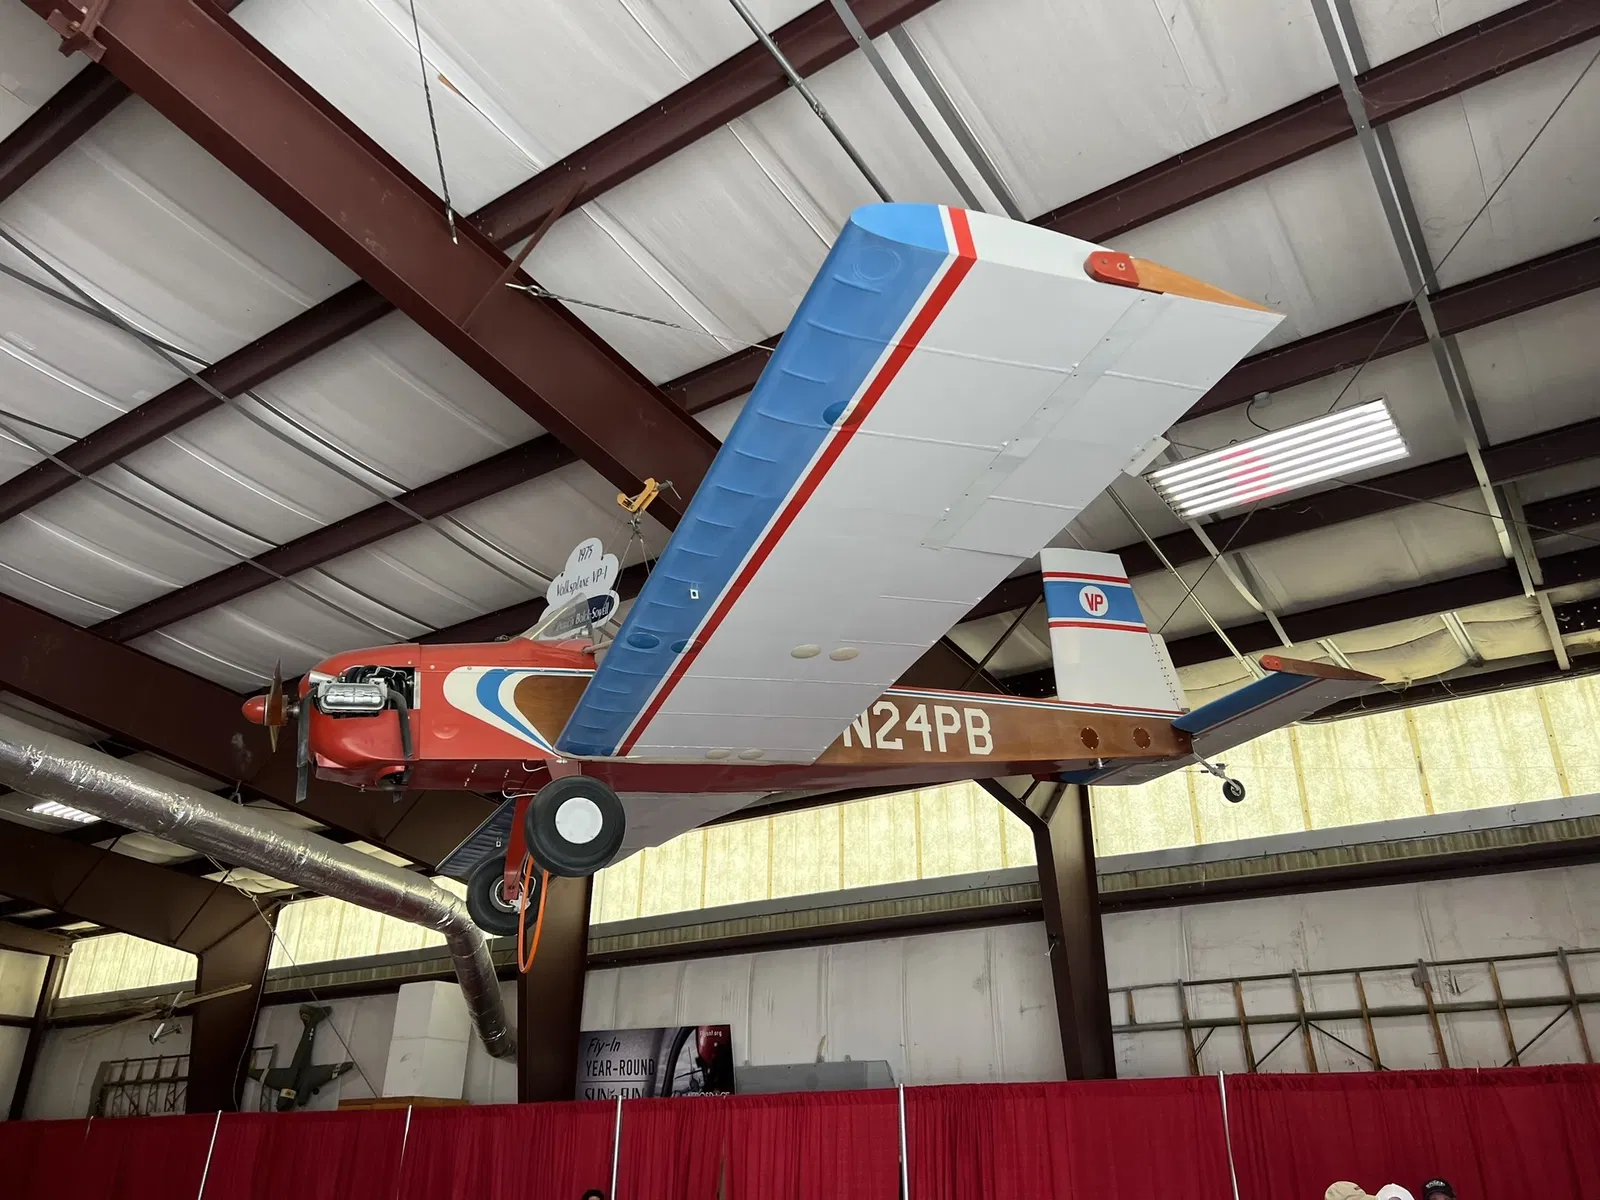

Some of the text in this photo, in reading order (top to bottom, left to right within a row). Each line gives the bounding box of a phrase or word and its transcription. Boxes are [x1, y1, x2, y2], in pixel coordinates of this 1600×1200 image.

[577, 544, 594, 562] 1975
[1084, 592, 1104, 612] VP
[843, 700, 994, 756] N24PB
[586, 1036, 621, 1058] Fly-In
[586, 1058, 656, 1077] YEAR-ROUND
